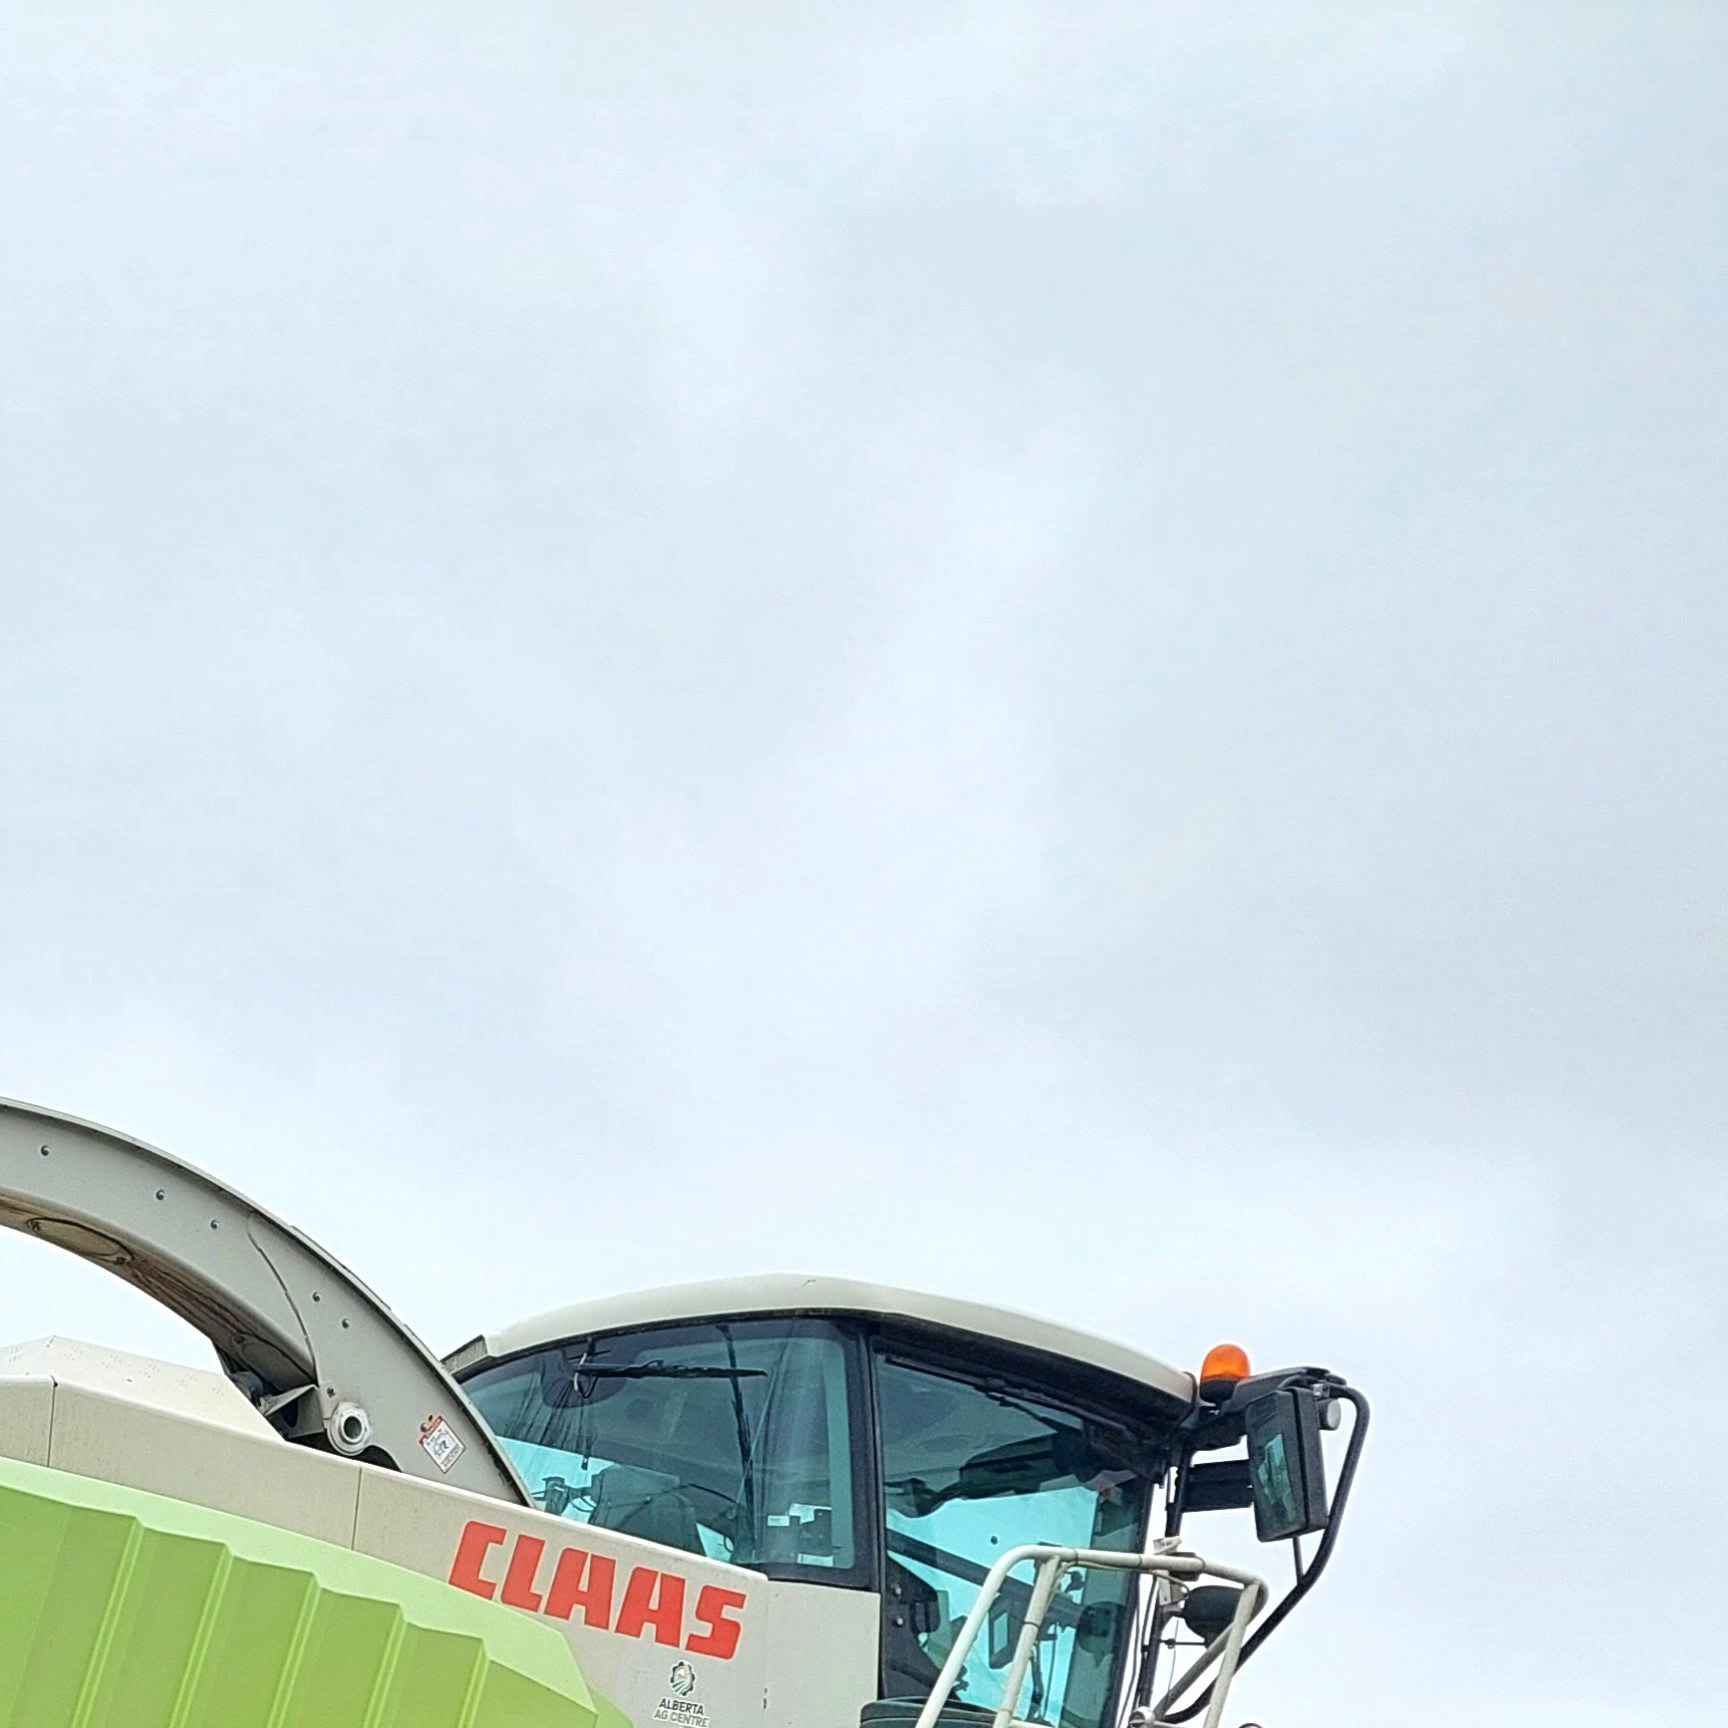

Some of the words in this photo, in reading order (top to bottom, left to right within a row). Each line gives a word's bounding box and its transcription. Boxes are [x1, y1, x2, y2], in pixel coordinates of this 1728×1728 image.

[449, 1520, 746, 1660] CLAAS
[658, 1698, 704, 1715] ALBERTA
[654, 1709, 668, 1720] AG
[670, 1712, 709, 1727] CENTRE
